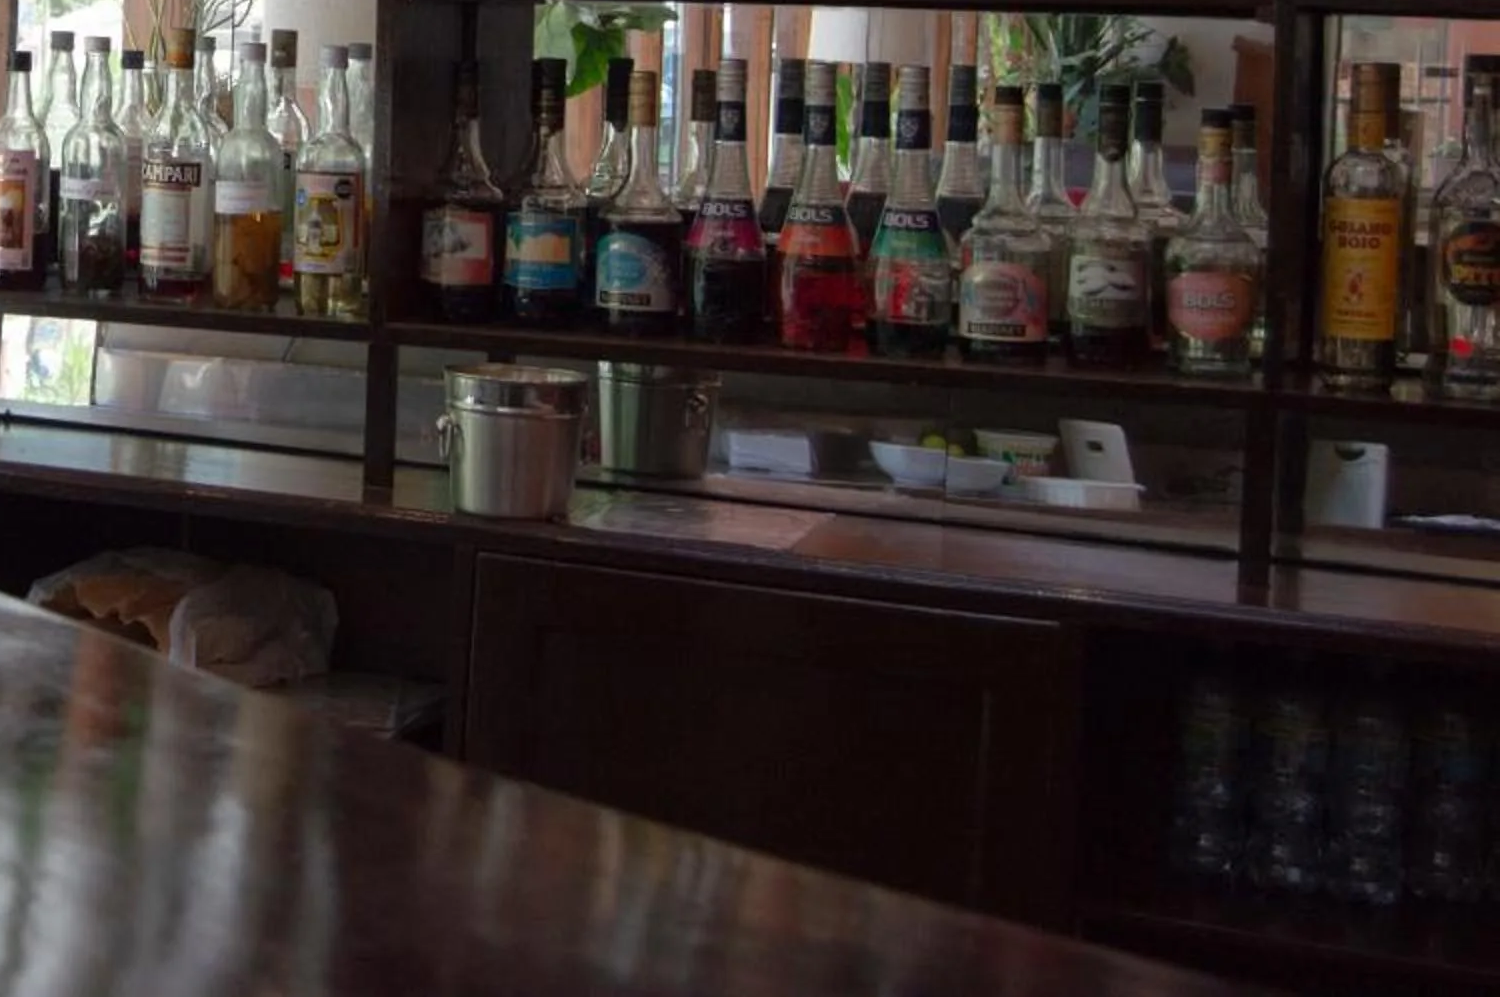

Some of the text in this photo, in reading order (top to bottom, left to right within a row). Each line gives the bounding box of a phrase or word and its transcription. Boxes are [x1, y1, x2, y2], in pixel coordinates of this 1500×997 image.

[141, 163, 198, 184] CAMPARI
[702, 202, 747, 217] BOLS
[789, 206, 833, 223] BOLS
[884, 212, 930, 229] BOLS
